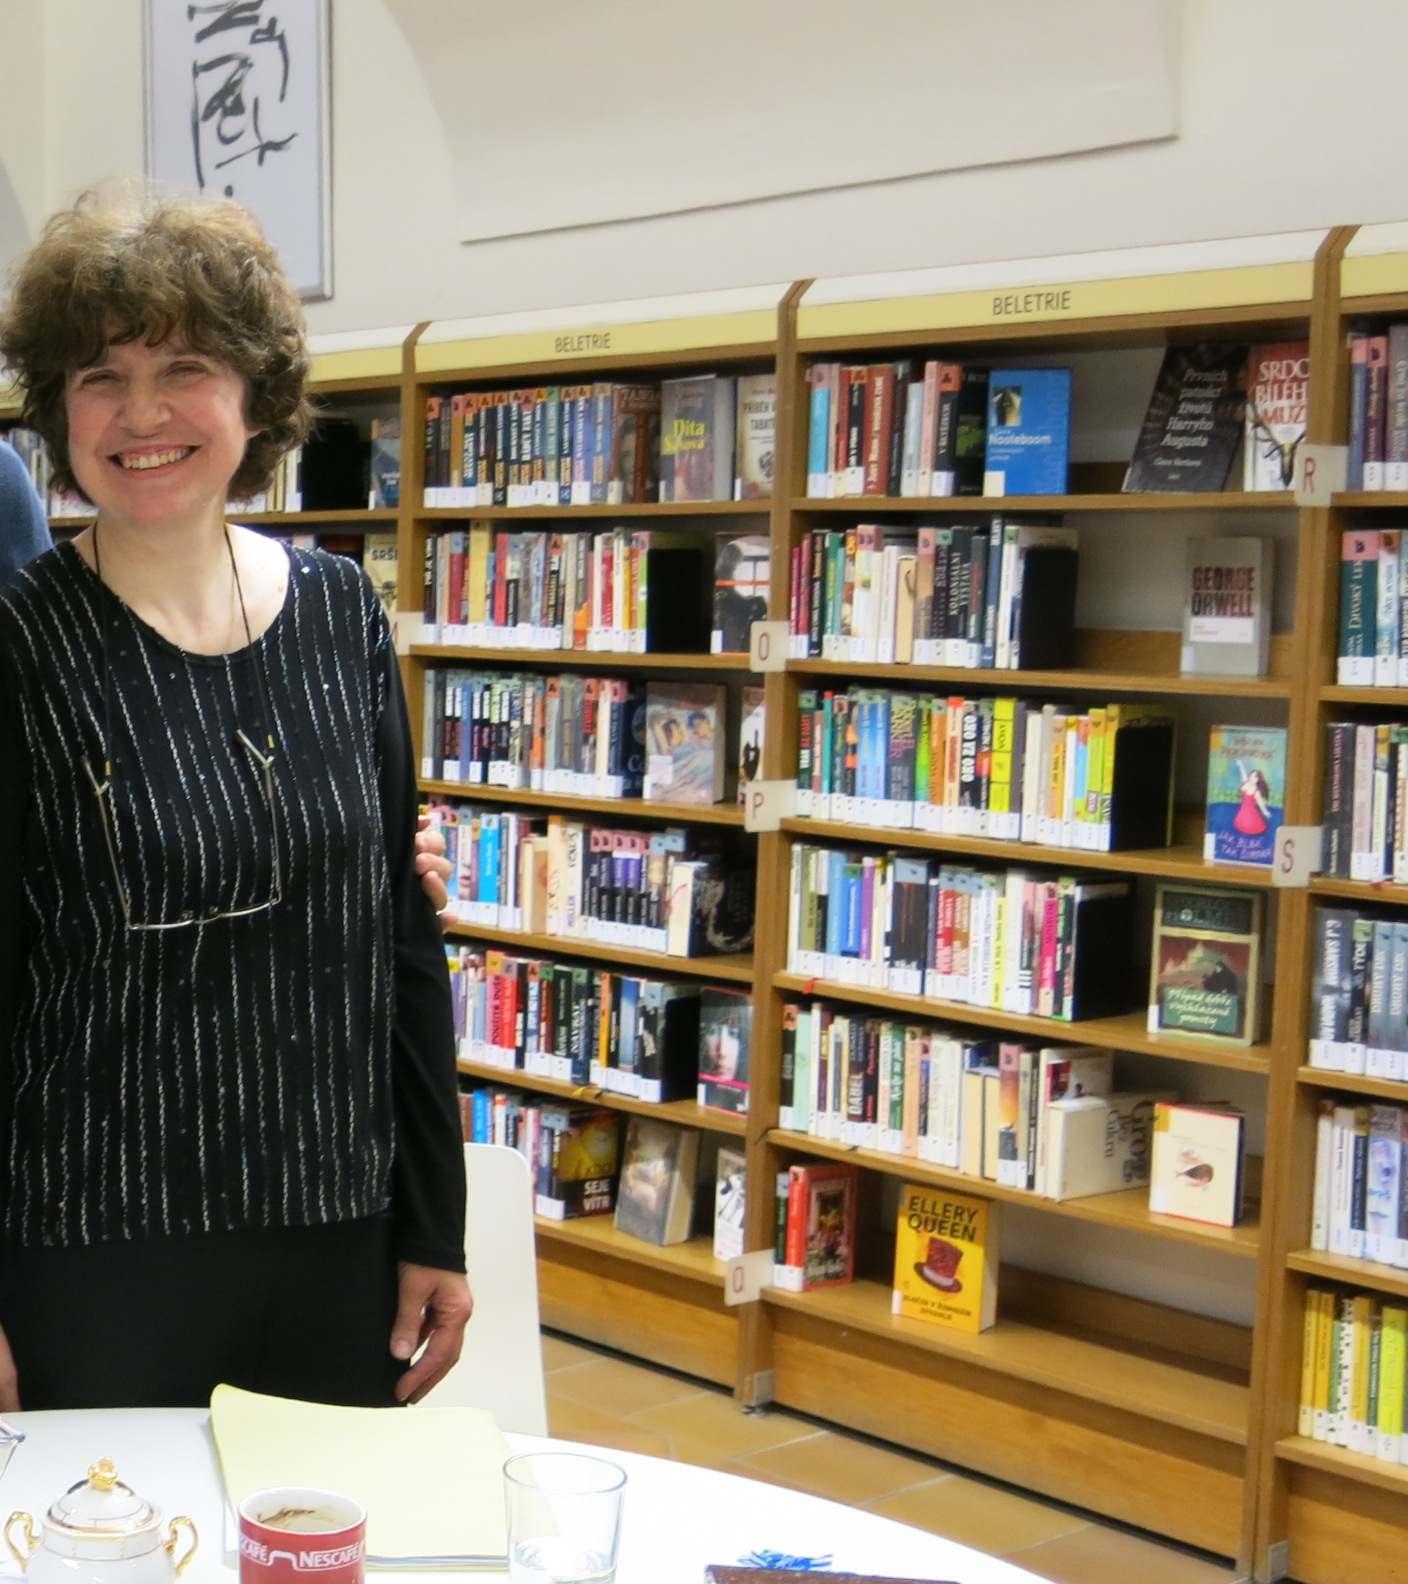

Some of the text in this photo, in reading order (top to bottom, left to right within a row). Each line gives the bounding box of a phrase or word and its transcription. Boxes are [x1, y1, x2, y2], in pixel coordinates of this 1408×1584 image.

[992, 290, 1072, 316] BELETRIE
[555, 332, 611, 353] BELETRIE
[1259, 358, 1310, 381] SRDC
[1255, 379, 1307, 404] BÍLÉH
[1303, 456, 1316, 492] R
[1193, 566, 1254, 592] GEORGE
[1192, 591, 1254, 617] ORWELL
[961, 714, 977, 783] OKO ZA OKO
[752, 792, 764, 819] P
[1281, 838, 1296, 874] S
[908, 1195, 979, 1225] ELLERY
[907, 1213, 977, 1243] QUEEN
[298, 1544, 360, 1568] NESCAFÉ
